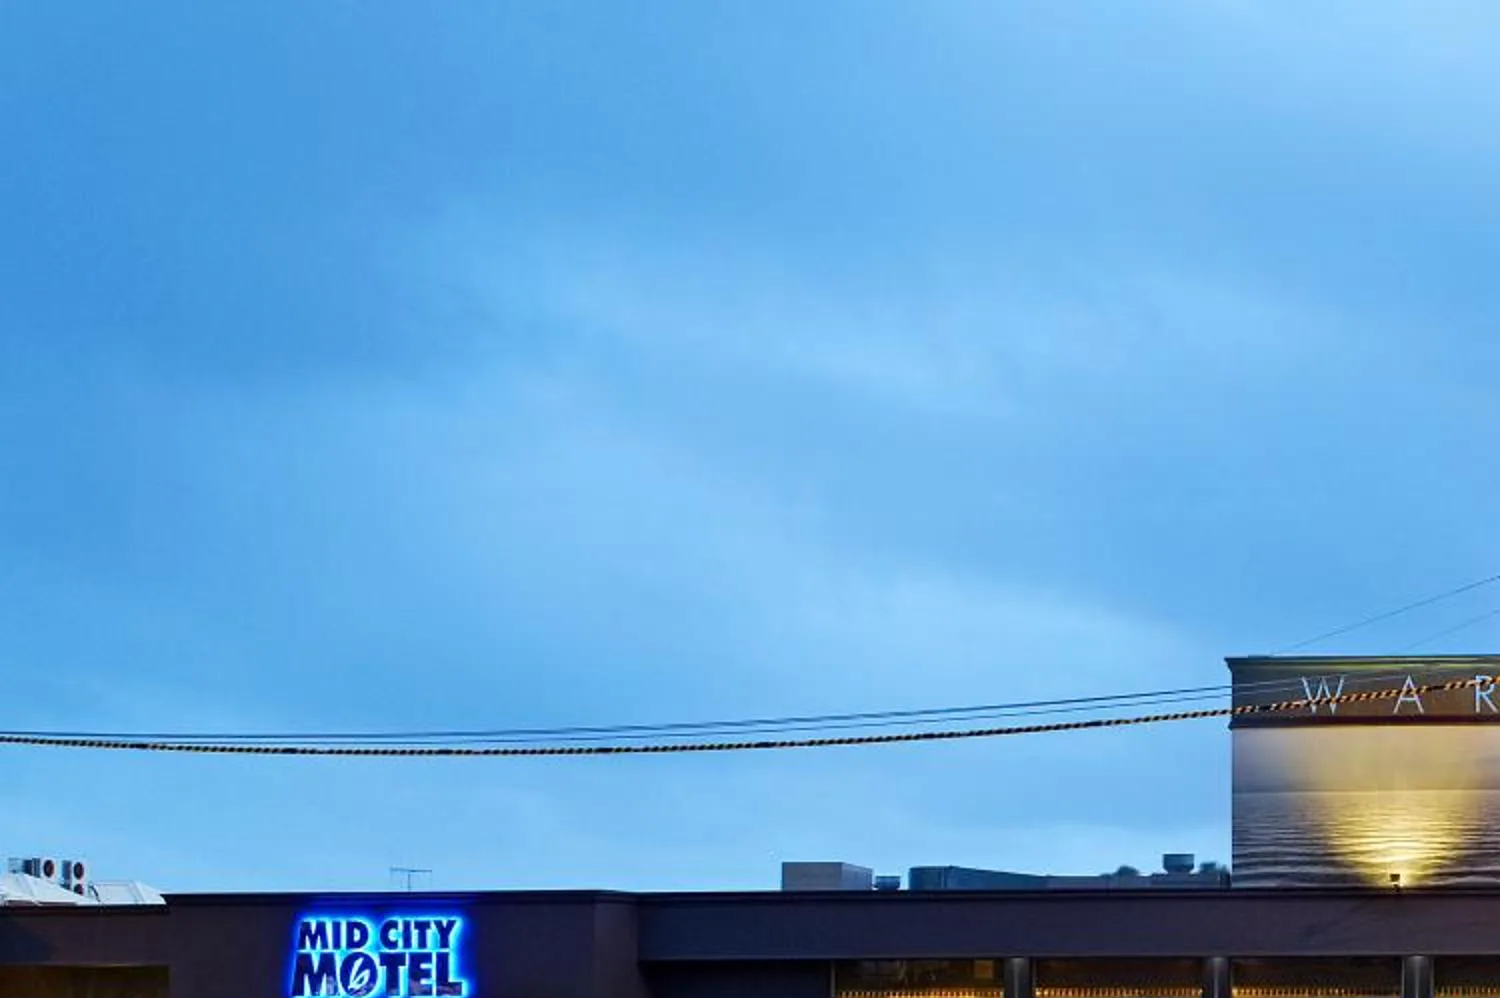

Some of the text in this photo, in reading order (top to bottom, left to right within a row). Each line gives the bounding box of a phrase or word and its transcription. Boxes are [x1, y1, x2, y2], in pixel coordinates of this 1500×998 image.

[300, 919, 457, 950] MID CITY
[292, 951, 463, 998] MOTEL
